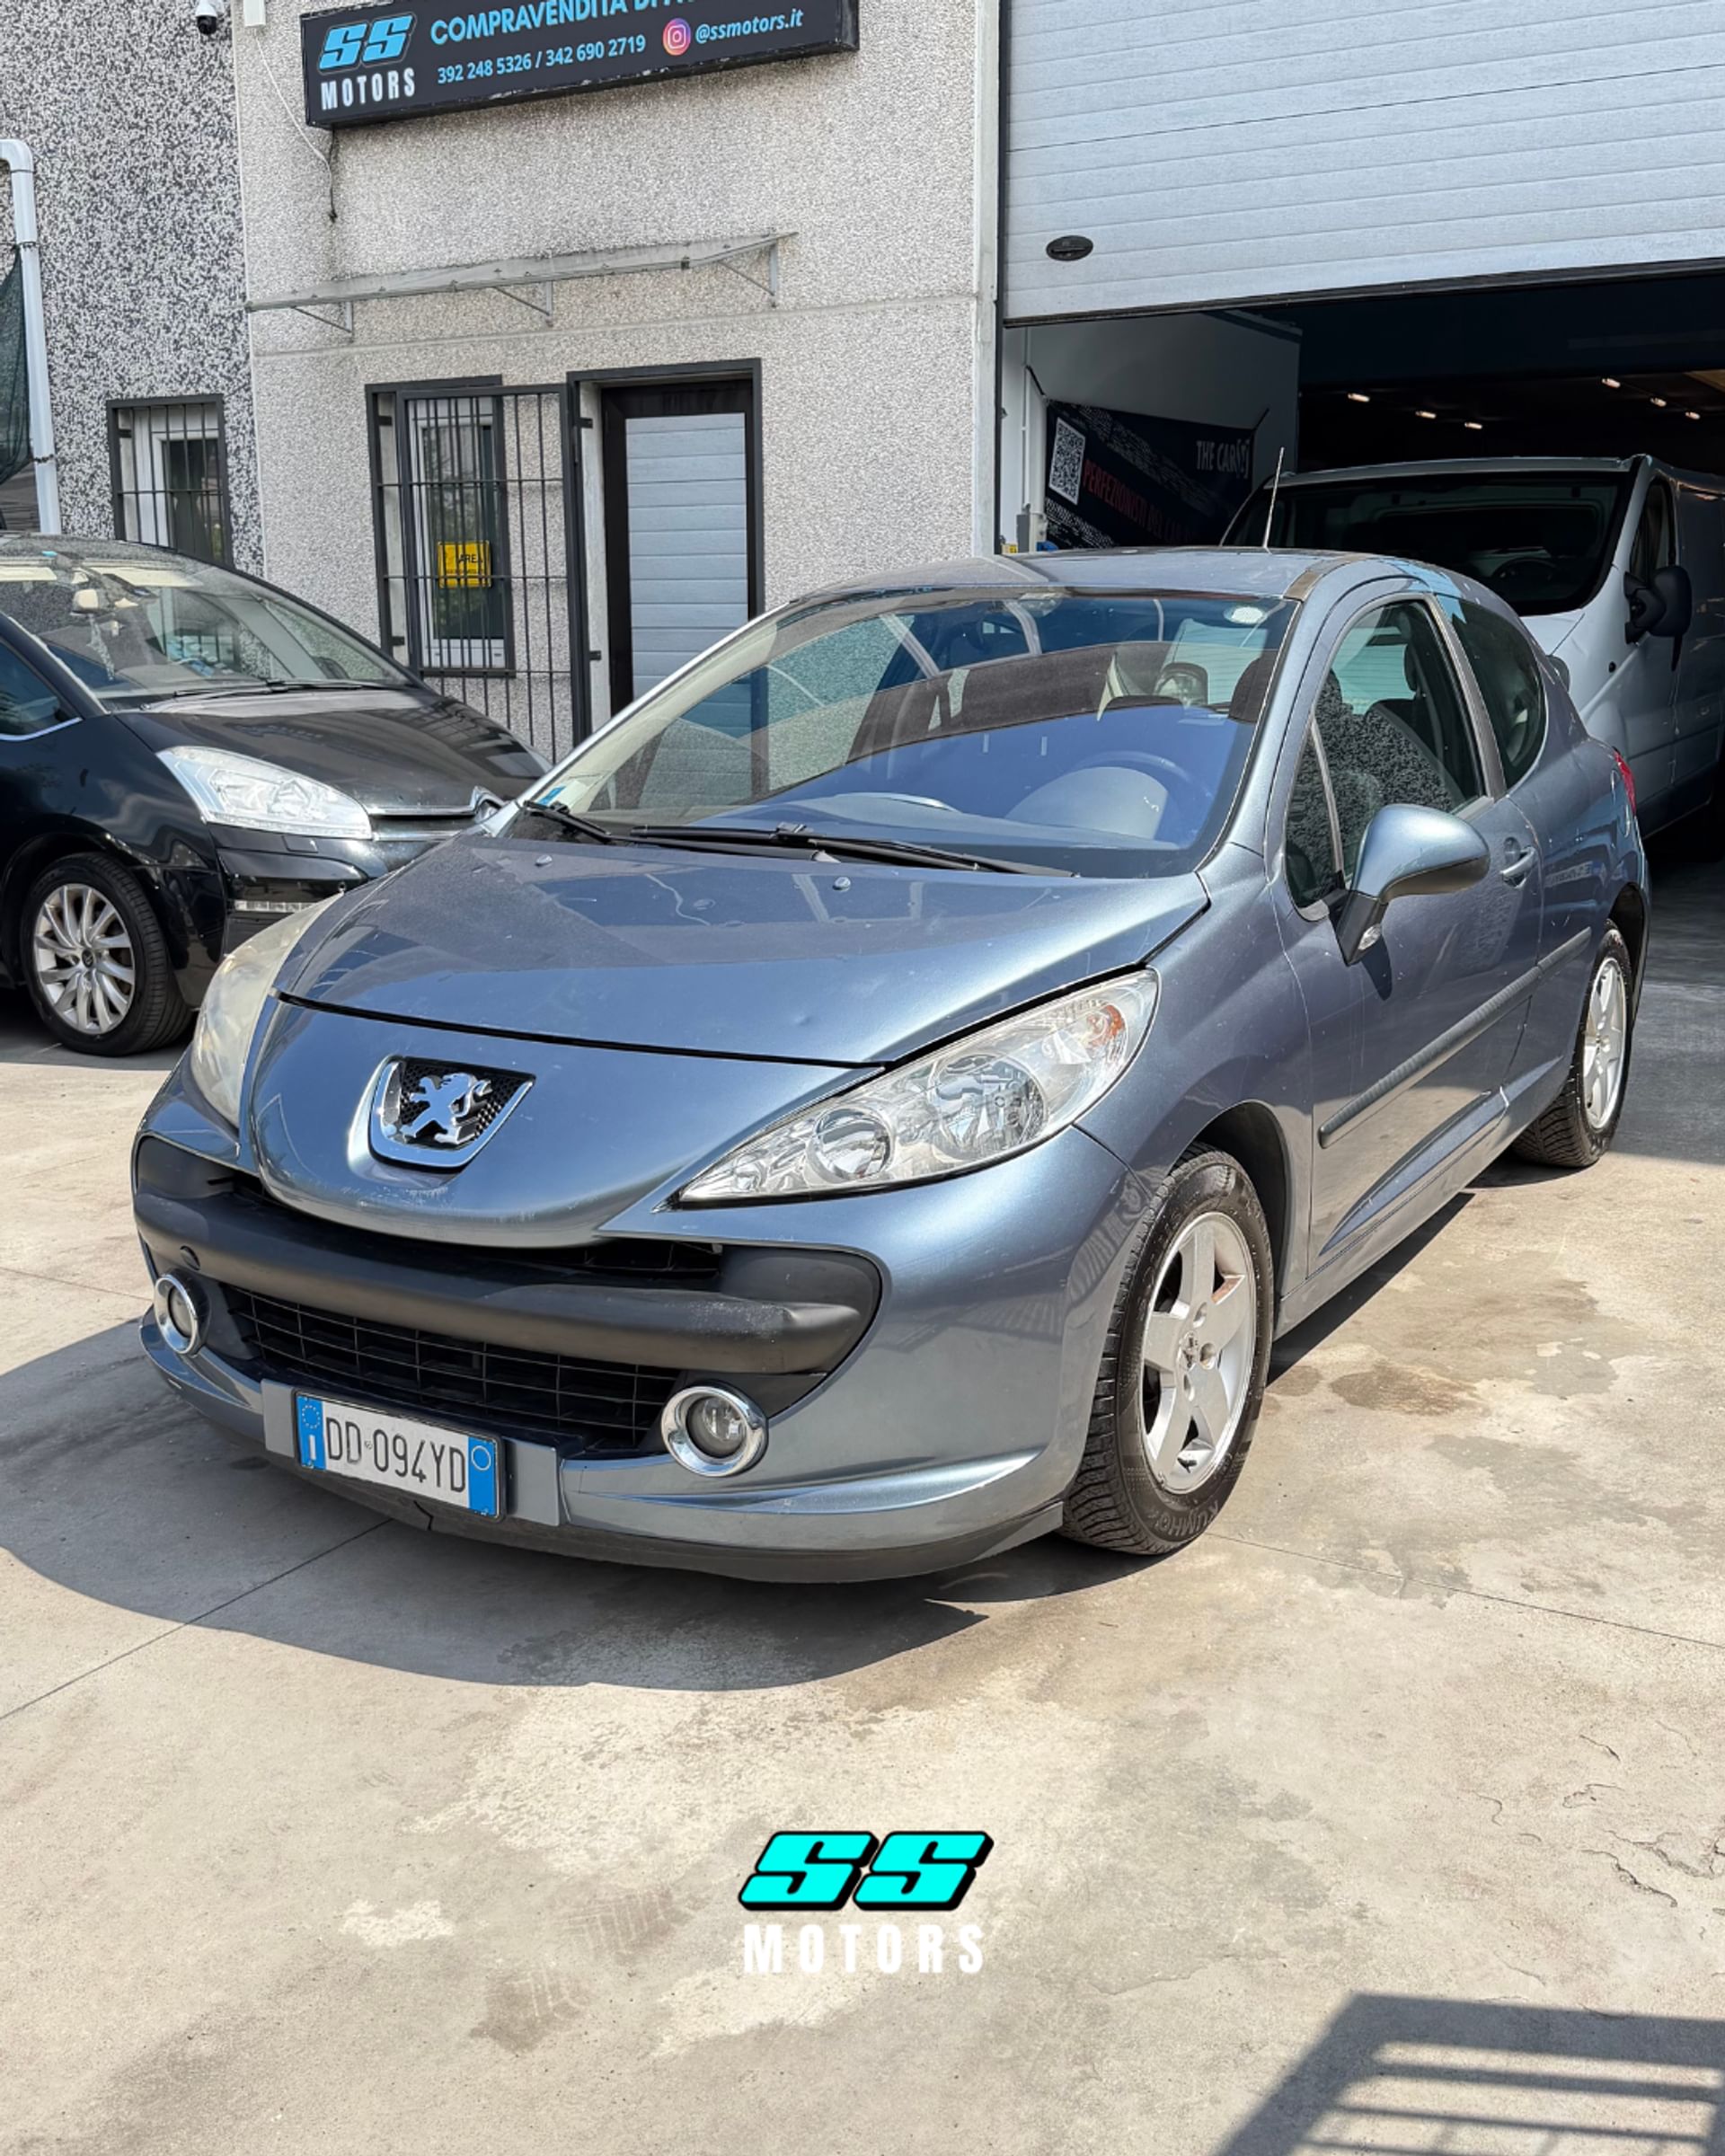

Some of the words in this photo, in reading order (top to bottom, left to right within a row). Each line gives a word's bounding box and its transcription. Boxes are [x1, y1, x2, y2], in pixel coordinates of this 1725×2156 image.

[318, 13, 414, 70] SS
[695, 8, 803, 44] @ssmotors.it
[438, 65, 464, 84] 392
[466, 60, 493, 80] 248
[497, 53, 532, 75] 5326
[535, 51, 542, 69] /
[545, 47, 572, 66] 342
[576, 42, 605, 62] 690
[608, 34, 646, 57] 2719
[321, 68, 415, 110] MOTORS
[1197, 440, 1215, 471] THE
[1159, 1499, 1218, 1537] KUMHO
